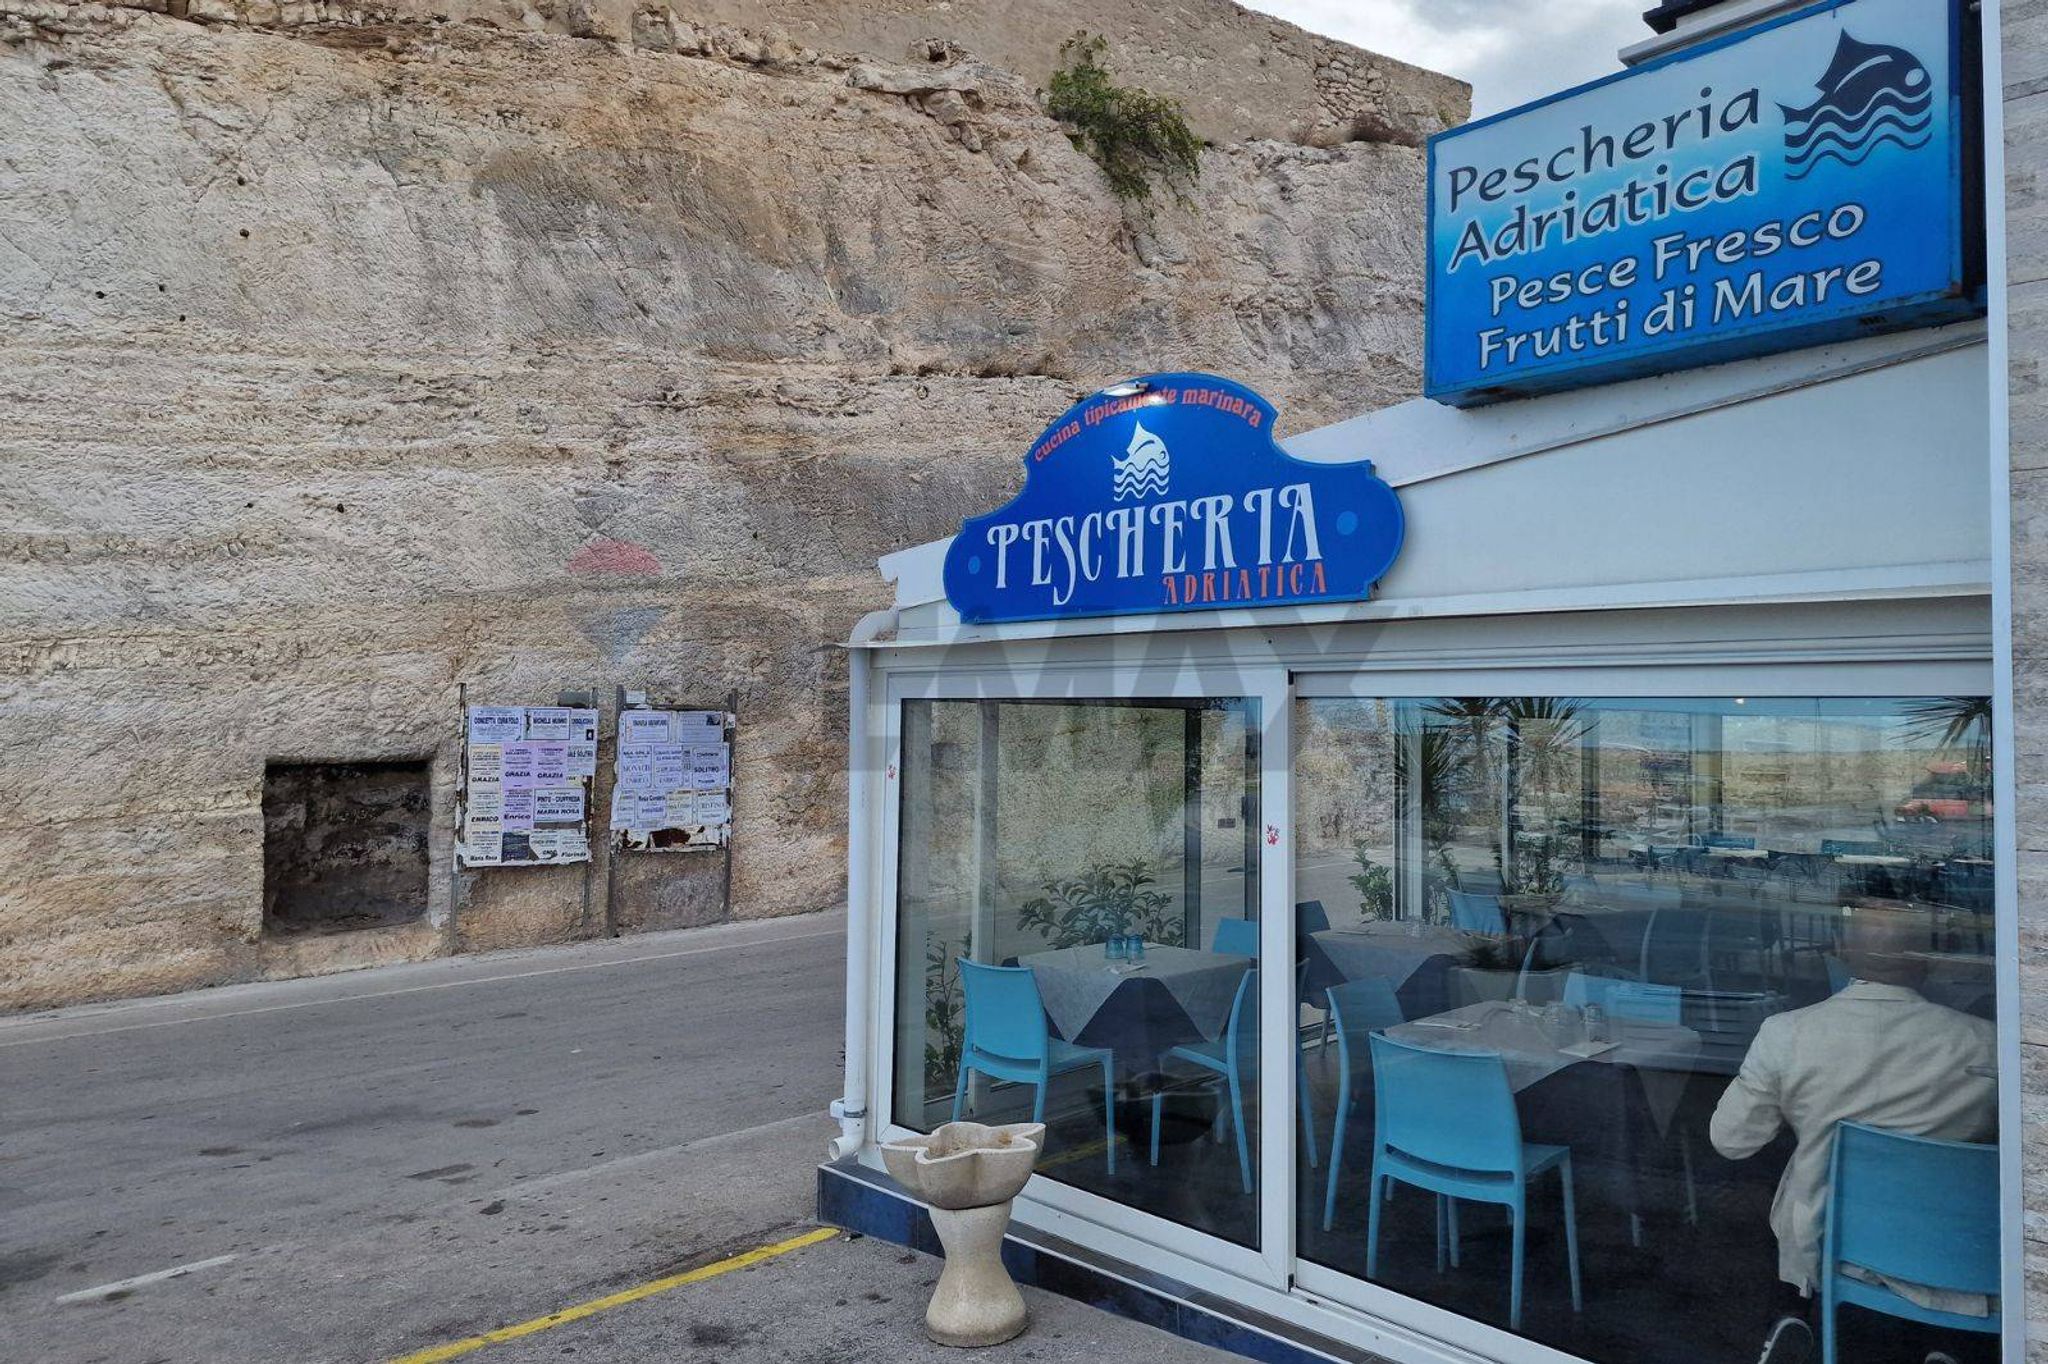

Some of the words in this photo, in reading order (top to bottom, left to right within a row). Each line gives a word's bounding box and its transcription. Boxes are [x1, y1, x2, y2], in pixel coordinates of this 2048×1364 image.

[1448, 86, 1760, 212] Pescheria
[1449, 154, 1759, 272] Adriatica
[1490, 255, 1638, 317] Pesce
[1653, 202, 1865, 280] Fresco
[1478, 299, 1628, 371] Frutti
[1643, 284, 1696, 337] di
[1713, 257, 1882, 325] Mare
[1035, 420, 1081, 462] cucina
[1182, 388, 1263, 429] marinara
[987, 482, 1322, 606] PESCHERIA
[1162, 560, 1328, 605] ADRIATICA
